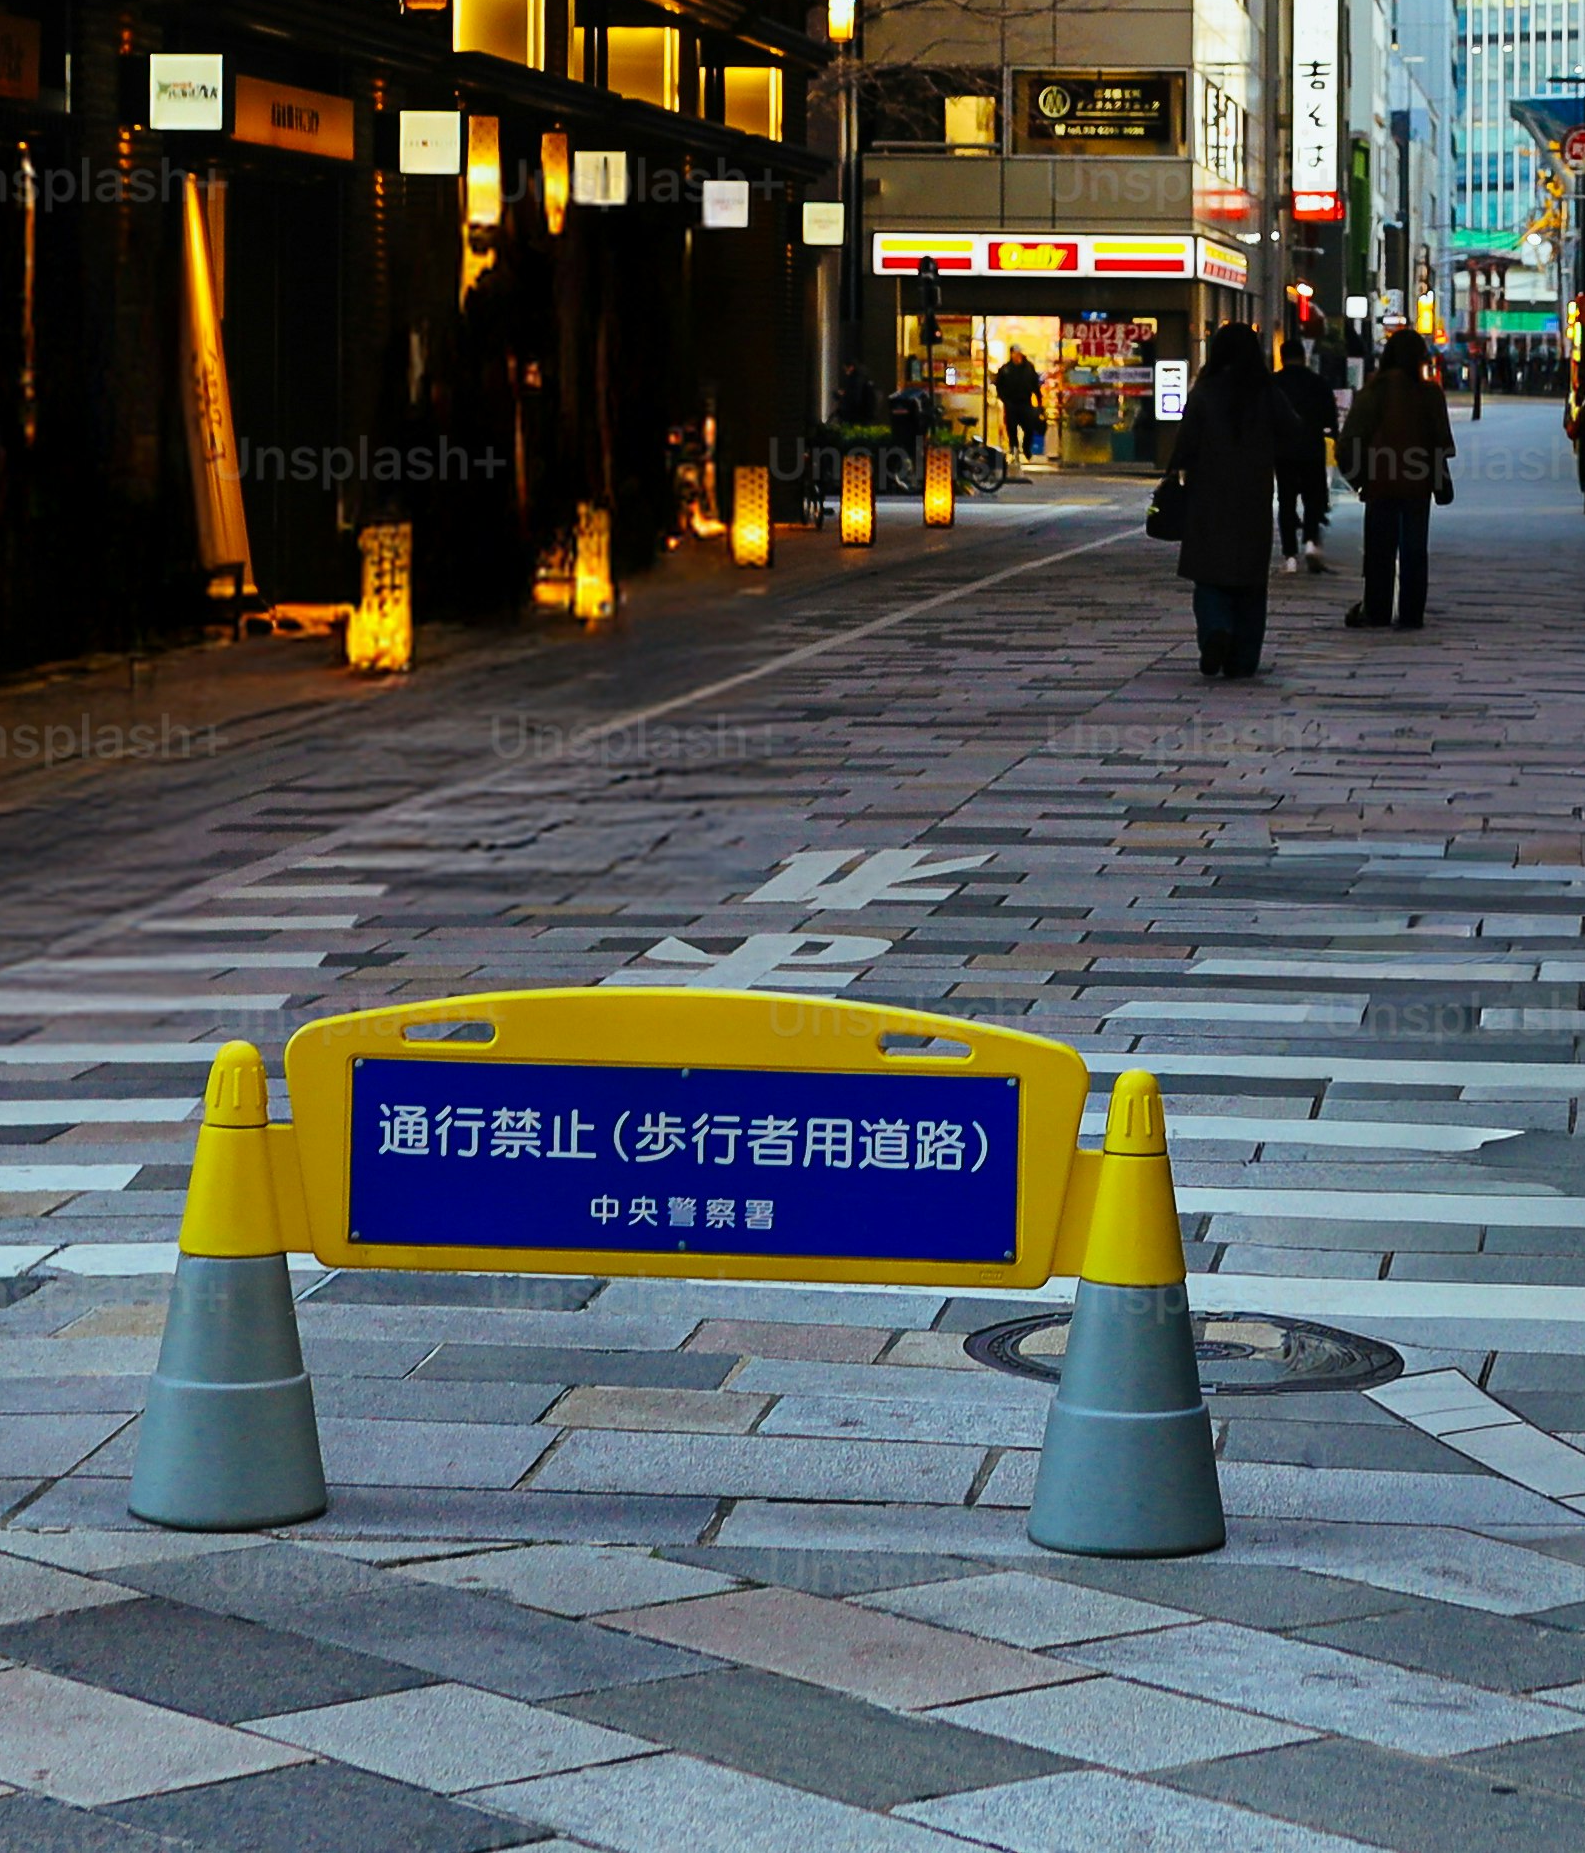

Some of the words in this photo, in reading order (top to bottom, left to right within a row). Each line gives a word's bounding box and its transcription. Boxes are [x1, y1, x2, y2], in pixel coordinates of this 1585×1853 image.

[997, 241, 1069, 272] Daily
[377, 1104, 990, 1175] 通行禁止（歩行者用道路）
[589, 1193, 776, 1233] 中央警察署
